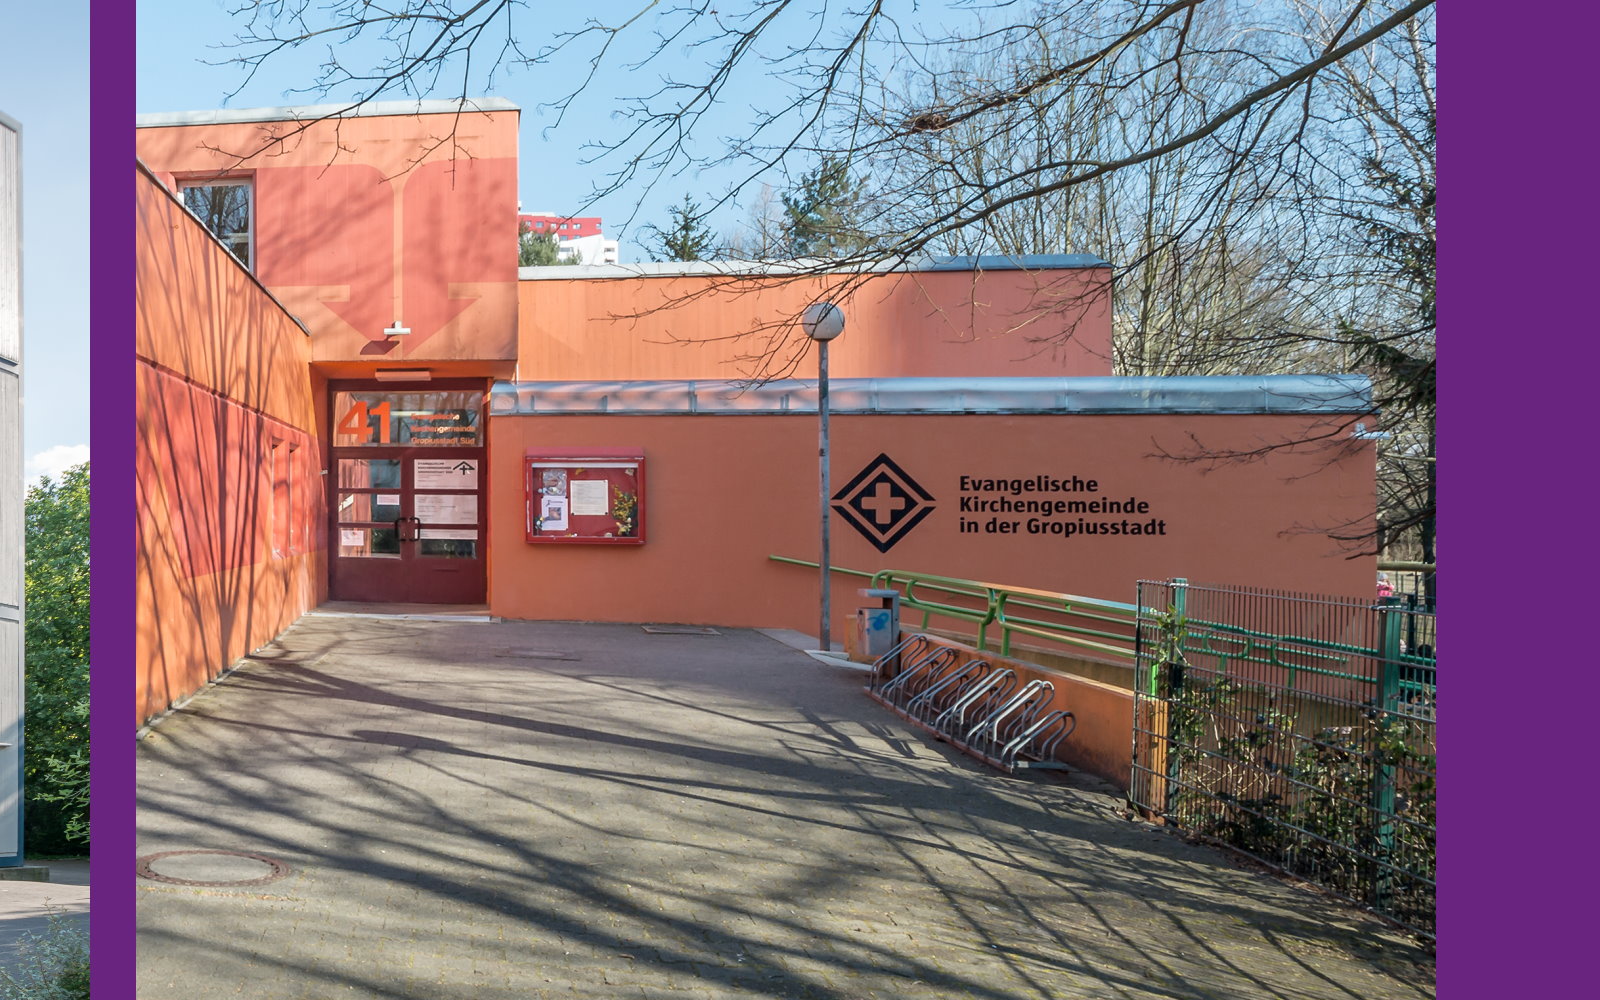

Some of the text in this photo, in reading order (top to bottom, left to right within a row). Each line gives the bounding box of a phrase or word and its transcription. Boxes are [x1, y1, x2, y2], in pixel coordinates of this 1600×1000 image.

[338, 401, 391, 444] 41
[959, 475, 1098, 495] Evangelische
[959, 496, 1150, 516] Kirchengemeinde
[959, 517, 1166, 538] in der Gropiusstadt
